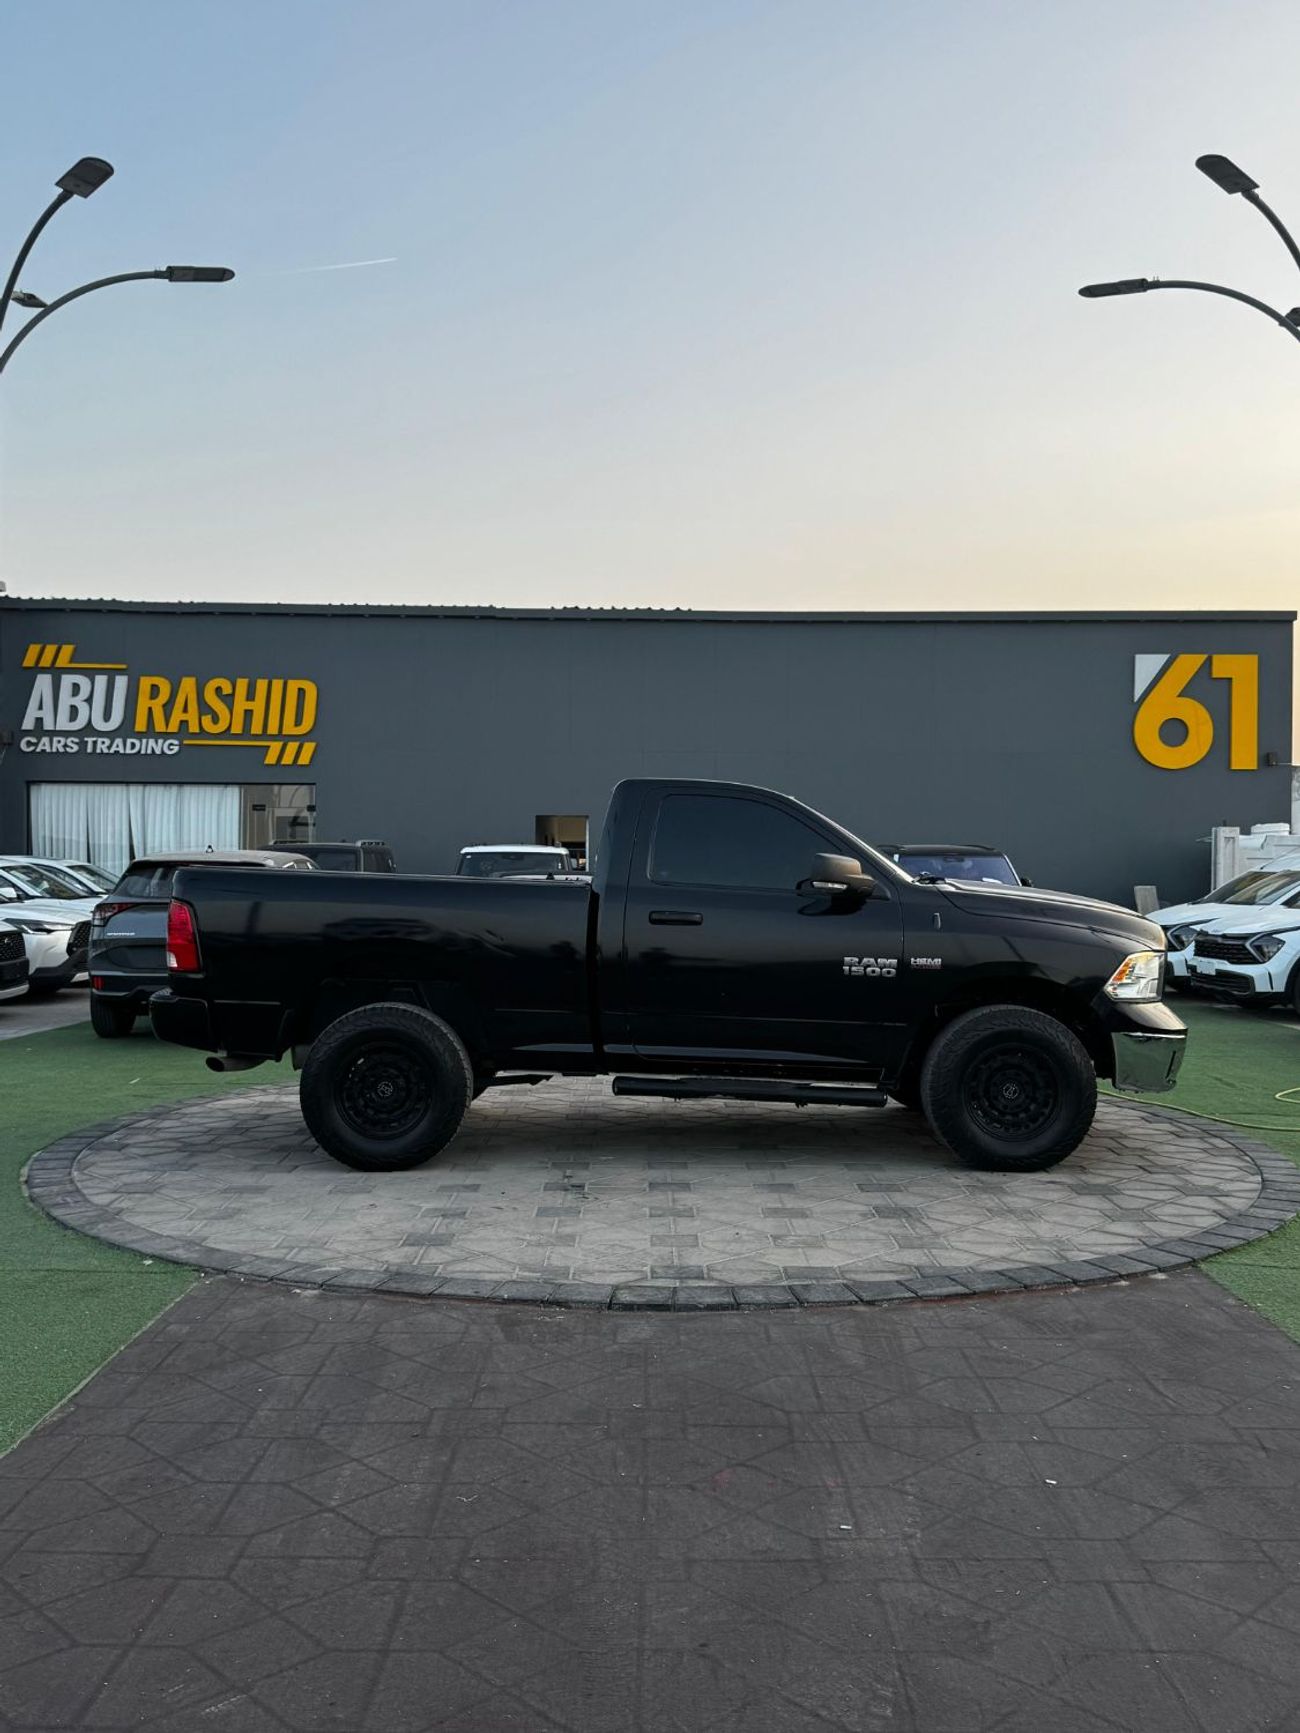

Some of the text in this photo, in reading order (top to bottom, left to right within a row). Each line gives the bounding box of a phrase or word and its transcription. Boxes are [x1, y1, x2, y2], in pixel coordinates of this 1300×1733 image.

[21, 673, 318, 735] ABU RASHID
[1133, 653, 1259, 770] 61
[19, 736, 180, 755] CARS TRADING
[843, 956, 898, 968] RAM
[910, 957, 942, 965] HEMI
[842, 966, 897, 977] 1500
